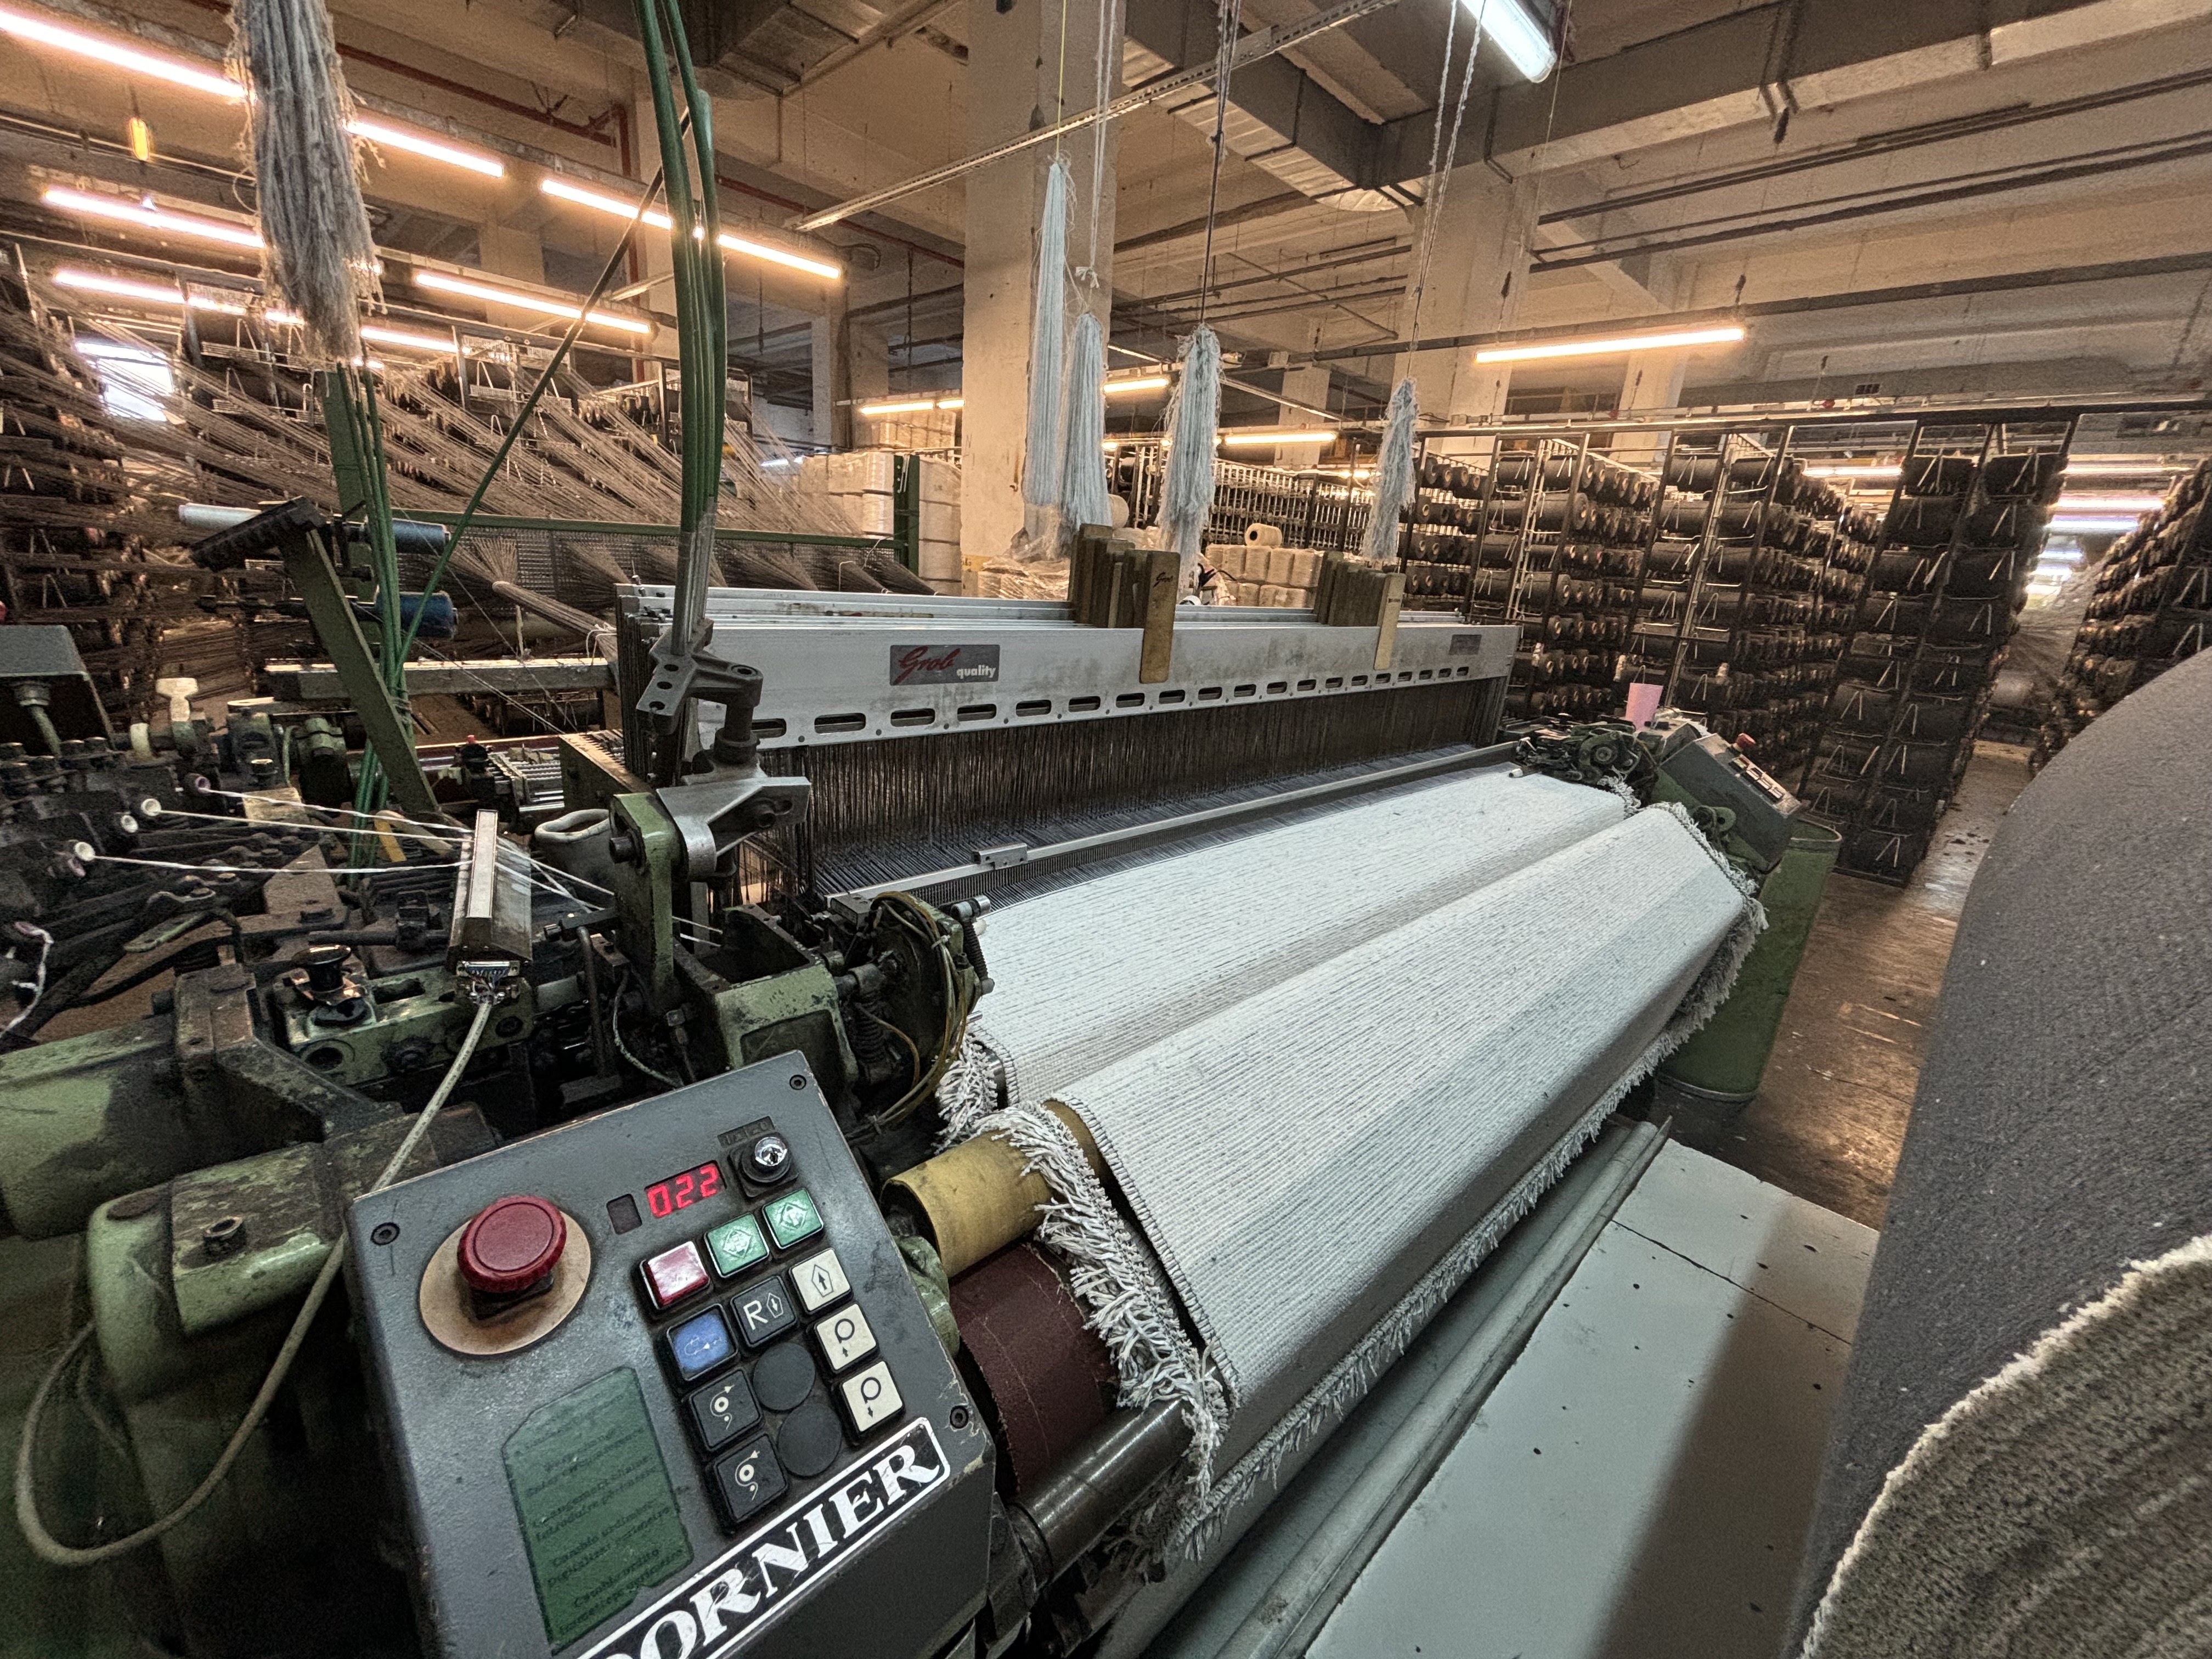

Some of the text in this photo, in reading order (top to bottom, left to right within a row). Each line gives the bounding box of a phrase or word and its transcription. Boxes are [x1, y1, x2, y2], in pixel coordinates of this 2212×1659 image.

[893, 645, 996, 686] Grob quality
[646, 1165, 718, 1219] 022
[743, 1300, 769, 1330] R
[605, 1445, 940, 1659] ORNIER
